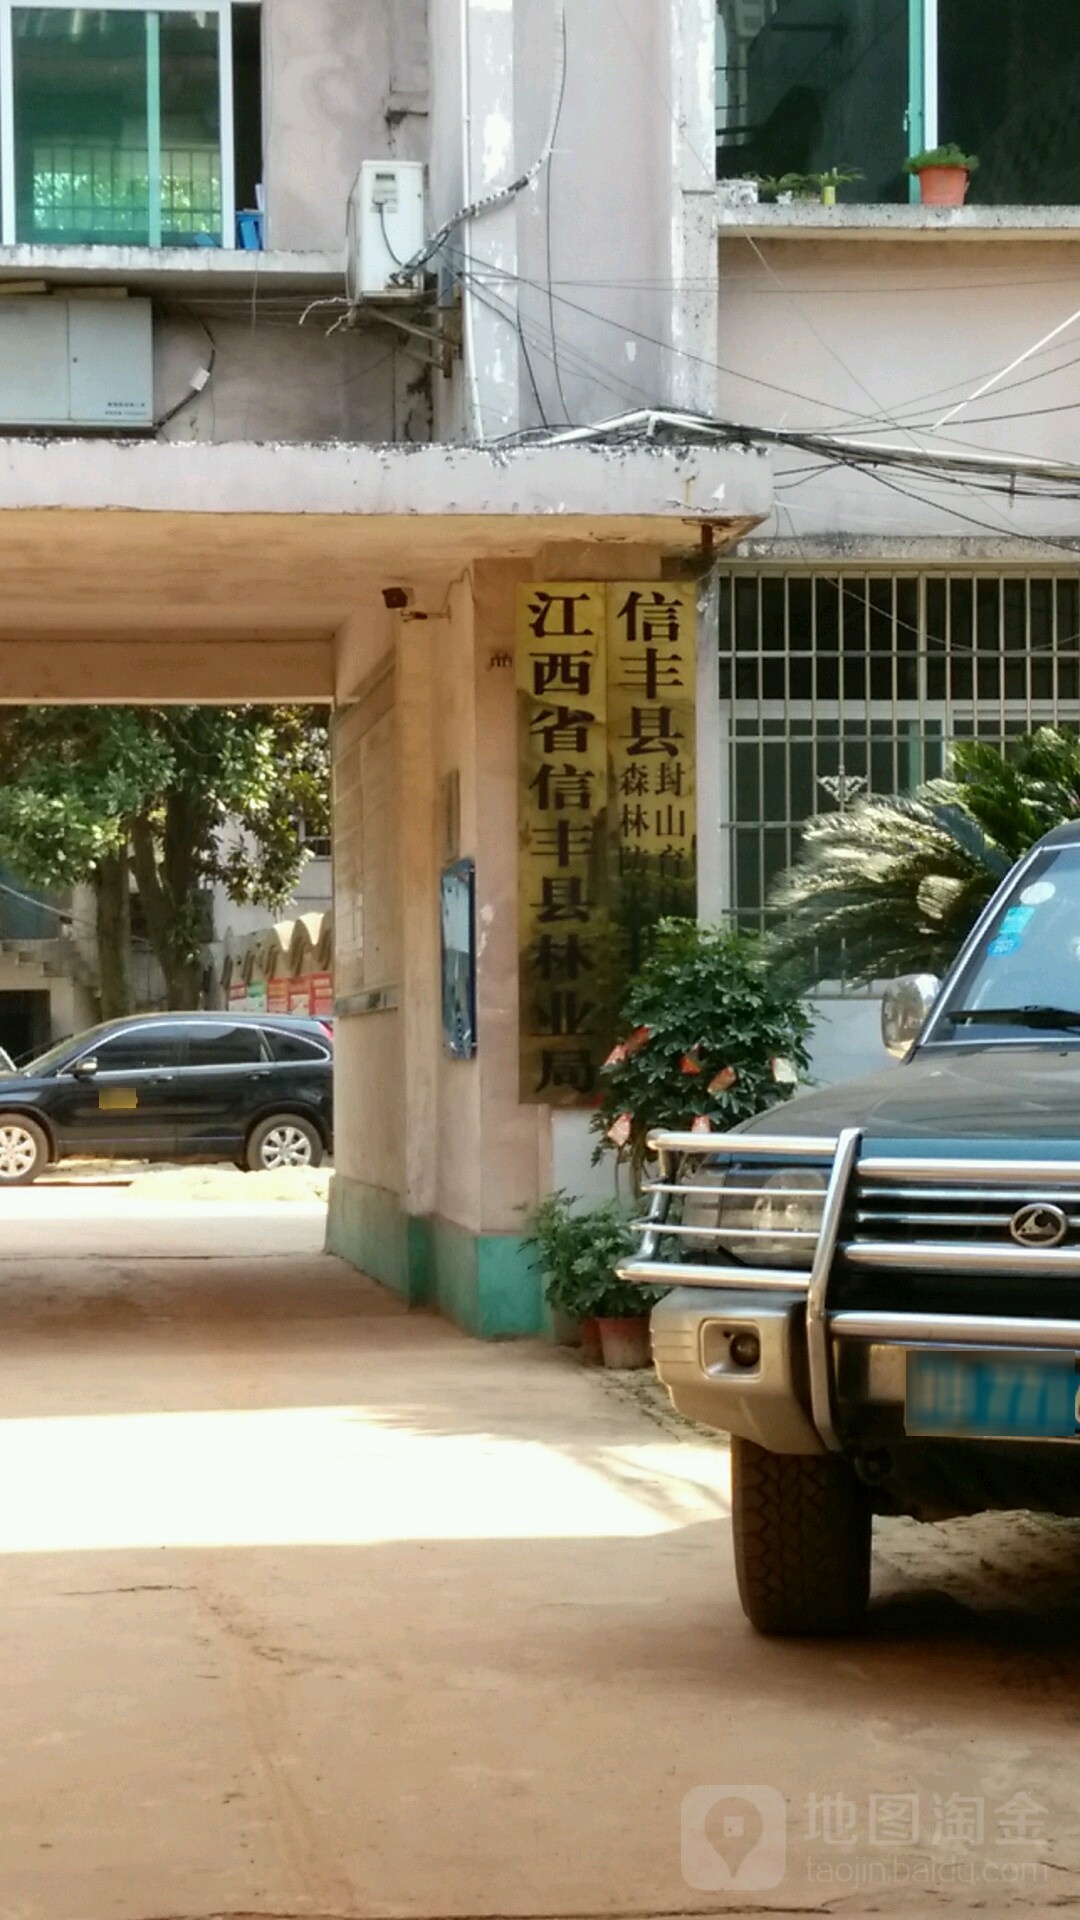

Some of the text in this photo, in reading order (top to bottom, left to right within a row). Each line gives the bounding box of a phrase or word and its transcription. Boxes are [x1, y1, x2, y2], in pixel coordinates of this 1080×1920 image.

[527, 591, 596, 1094] 江西省信丰县林业局
